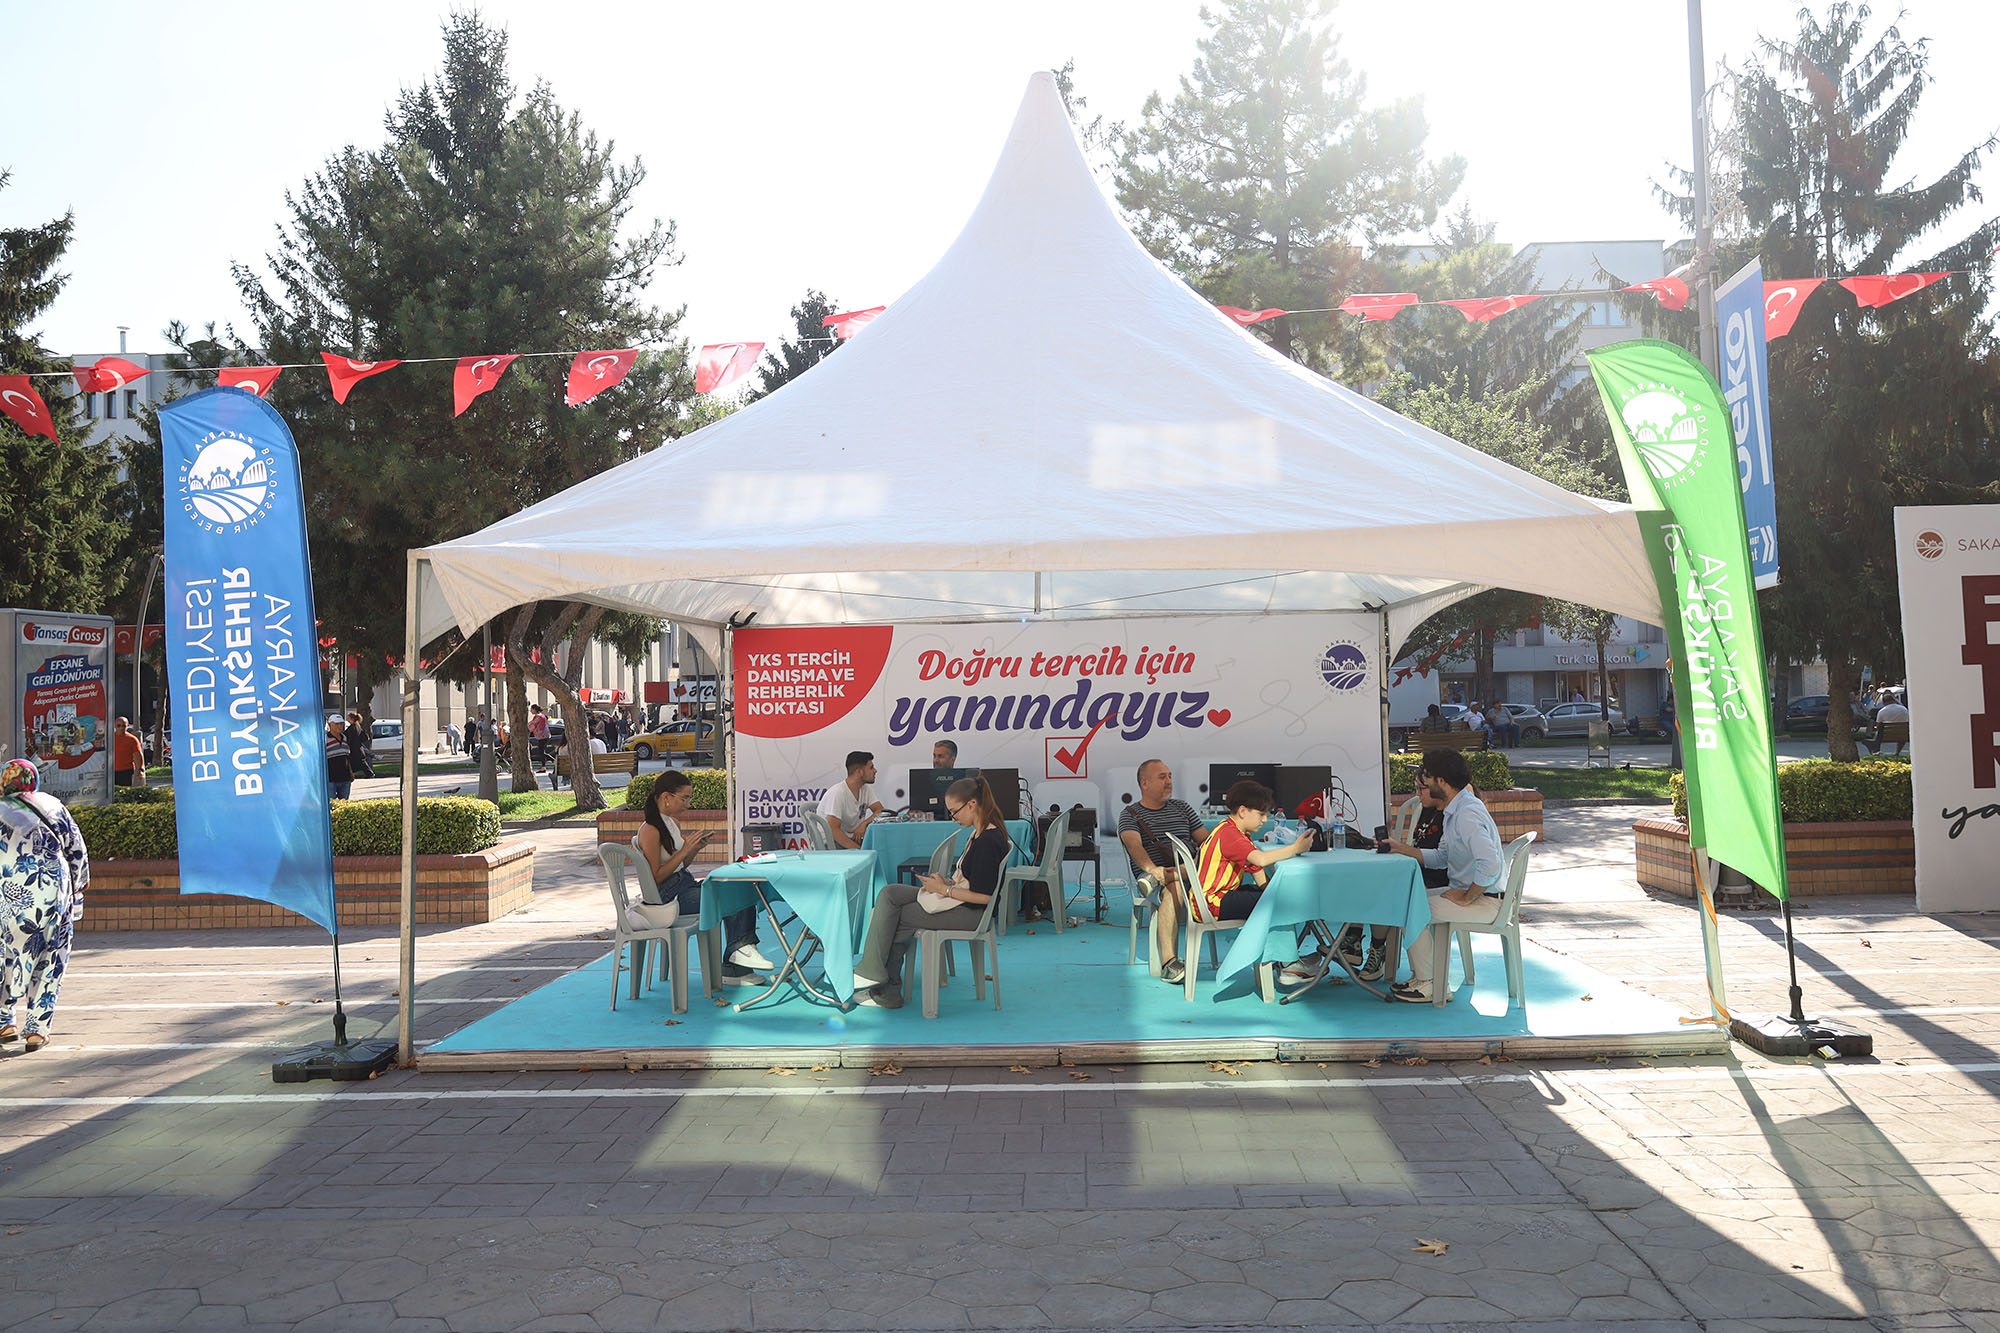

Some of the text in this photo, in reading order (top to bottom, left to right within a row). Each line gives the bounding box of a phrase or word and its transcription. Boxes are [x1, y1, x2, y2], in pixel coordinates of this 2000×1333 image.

[32, 625, 101, 643] Tansaş Gross
[50, 658, 84, 671] EFSANE
[748, 649, 850, 667] YKS TERCİH
[918, 645, 1196, 686] Doğru tercih için
[1556, 654, 1631, 664] Türk Telkom
[32, 667, 100, 686] GERİ DÖNÜYOR!
[748, 668, 855, 684] DANIŞMA VE
[748, 682, 845, 699] REHBERLİK
[748, 701, 824, 715] NOKTASI
[888, 679, 1210, 746] yanındayız
[749, 802, 801, 818] BÜYÜ
